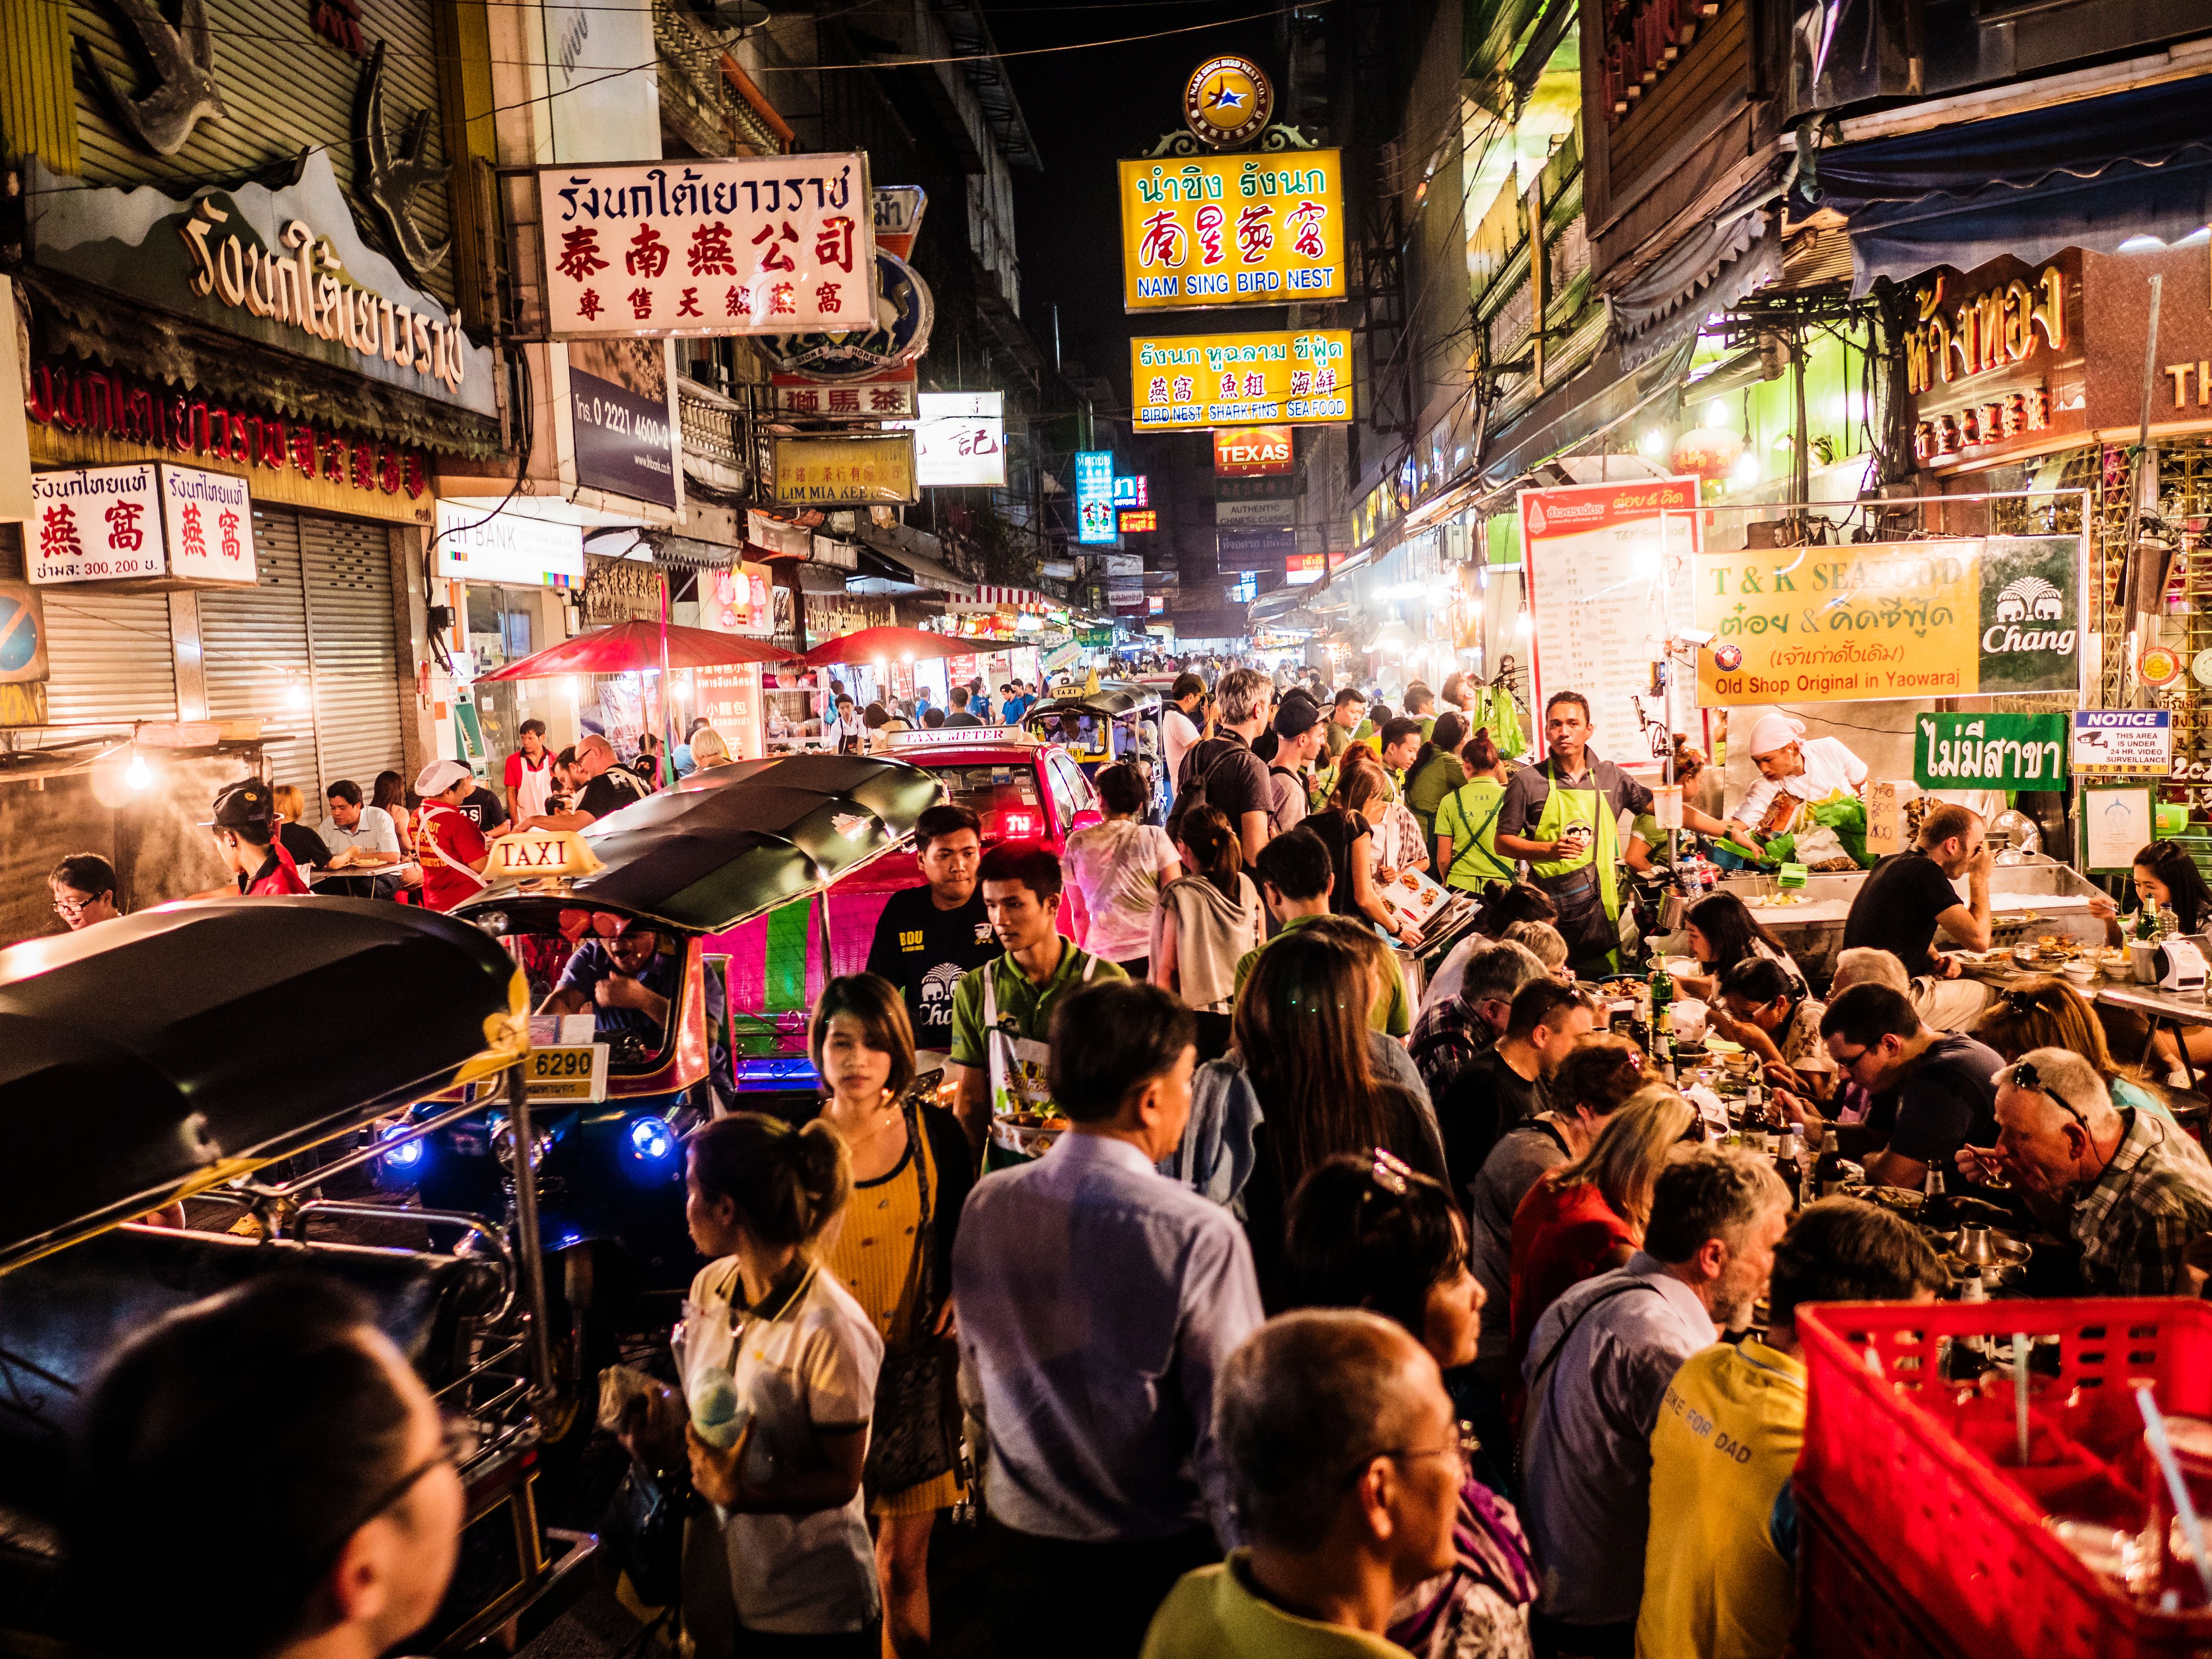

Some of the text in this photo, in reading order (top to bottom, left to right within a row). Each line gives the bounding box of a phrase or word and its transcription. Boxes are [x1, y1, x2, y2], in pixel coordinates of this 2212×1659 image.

[1239, 162, 1325, 196] รังนก
[558, 165, 852, 221] รังนกใต้เยาวราช
[556, 216, 855, 283] 泰南燕公司
[181, 196, 465, 393] รังนกใต้เยาวราช
[1138, 268, 1333, 297] NAM SING BIRD NEST
[1903, 265, 2064, 395] ห้างทอง
[1141, 335, 1344, 371] รังนก หูฉลาม ซีฟู้ด
[1149, 368, 1337, 404] 燕窩 魚翅 海鮮
[593, 397, 602, 426] 0
[605, 401, 631, 436] 2221
[635, 414, 668, 450] 4600-2
[1142, 407, 1169, 423] BIRD
[1173, 406, 1202, 423] NEST
[1209, 404, 1249, 421] SHARK
[1252, 402, 1278, 419] FINS
[1218, 445, 1289, 463] TEXAS
[781, 485, 867, 500] LIM MIA KEE
[1647, 493, 1658, 506] &
[1660, 489, 1684, 504] คิด
[1220, 515, 1292, 525] CHINESE CUISINE
[1231, 505, 1280, 514] AUTHENTIC
[1546, 504, 1604, 519] ข้าวตราฉัตร
[41, 499, 144, 559] 燕窩
[182, 502, 241, 561] 燕窩
[448, 515, 516, 551] LH BANK
[1641, 525, 1687, 538] Seaood
[1711, 556, 1965, 596] T & K SEAFOOD
[1720, 595, 1954, 639] ต๋อย & คิดซีฟู้ด
[1982, 625, 2077, 655] Chang
[632, 688, 657, 703] Seood
[1715, 669, 1960, 696] Old Shop Original in Yaowaraj
[707, 701, 747, 716] 小籠包
[2087, 713, 2157, 727] NOTICE
[1920, 718, 2061, 779] ไม่มีสาขา
[1872, 787, 1894, 800] 250
[1872, 801, 1894, 812] 500
[500, 840, 567, 867] TAXI
[899, 930, 923, 946] BDU
[919, 1003, 952, 1026] Cha
[536, 1052, 591, 1076] 6290
[1685, 1408, 1713, 1439] FOR
[1714, 1432, 1752, 1464] DAD
